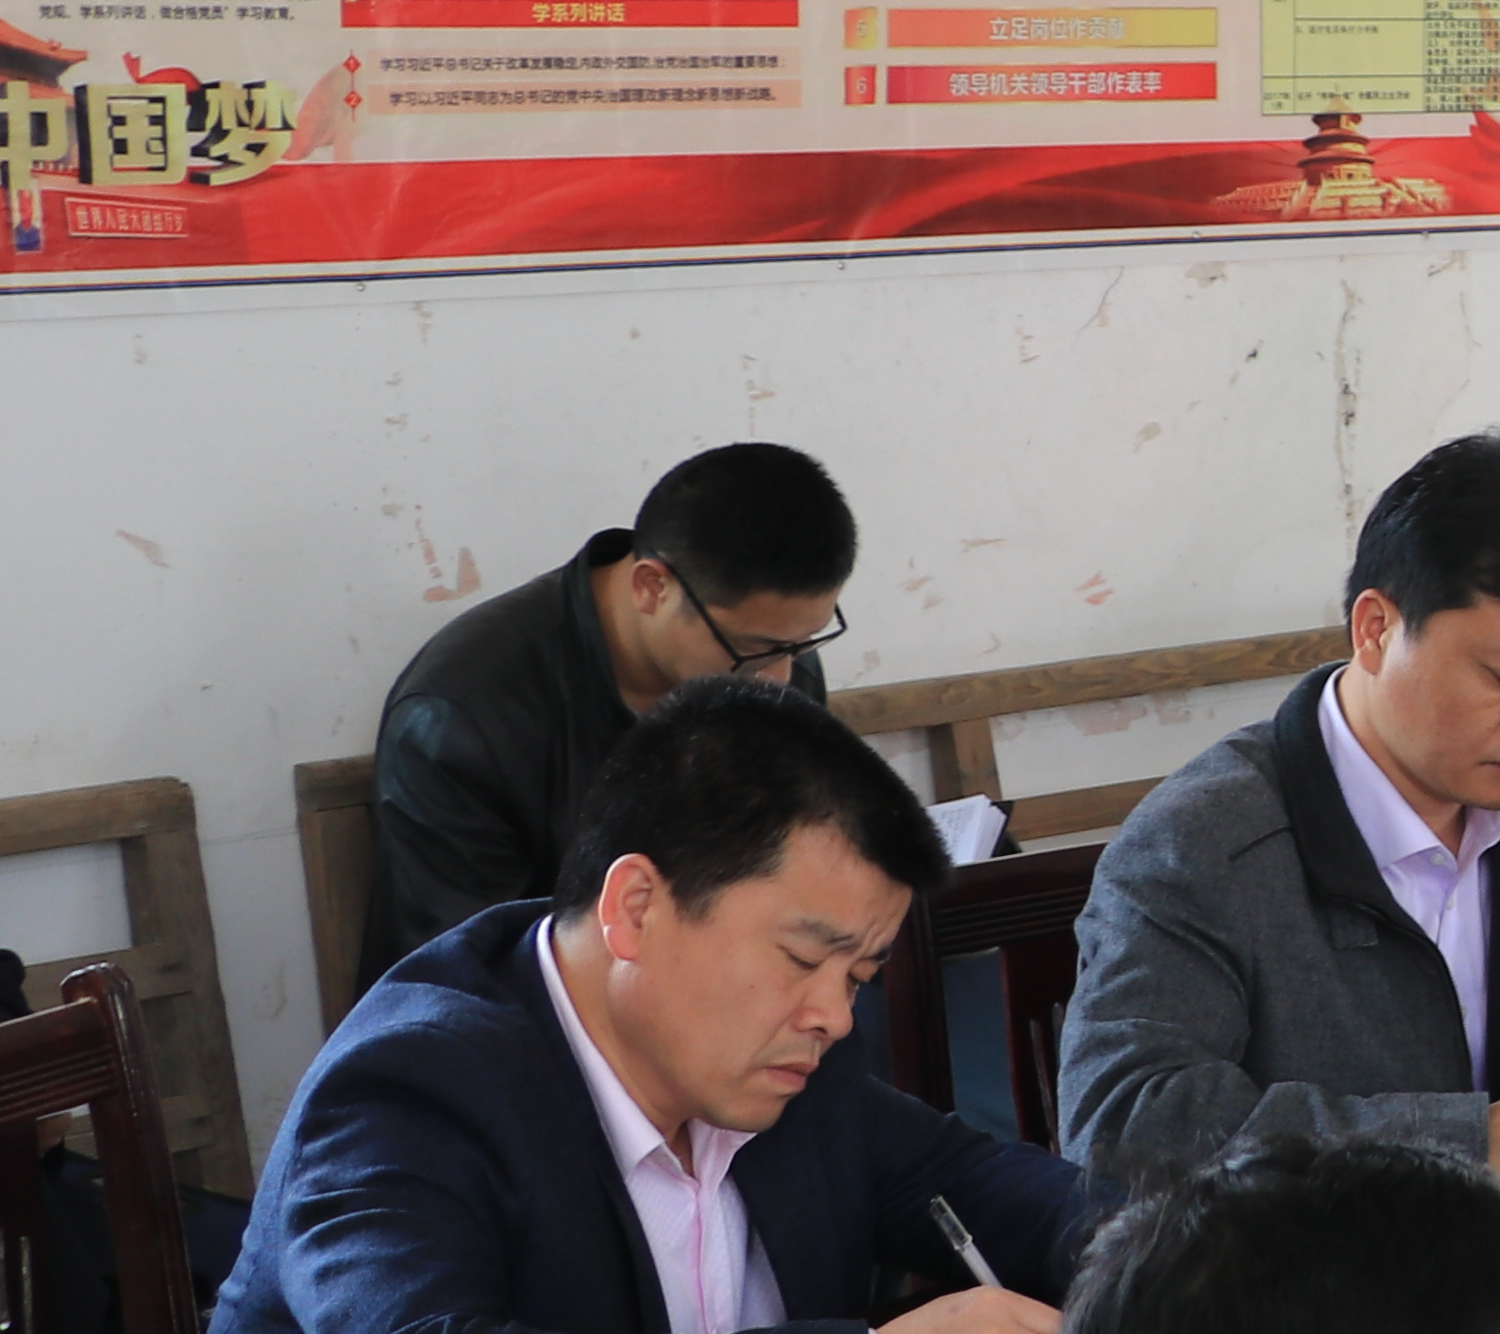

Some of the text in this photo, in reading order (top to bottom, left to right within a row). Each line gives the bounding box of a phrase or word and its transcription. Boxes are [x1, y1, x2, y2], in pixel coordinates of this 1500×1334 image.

[531, 1, 627, 24] 学系列讲话
[989, 17, 1126, 42] 立足岗位作贡献
[855, 77, 867, 94] 6
[949, 71, 1163, 98] 领导机关领导干部作表率
[0, 80, 297, 191] 中国梦
